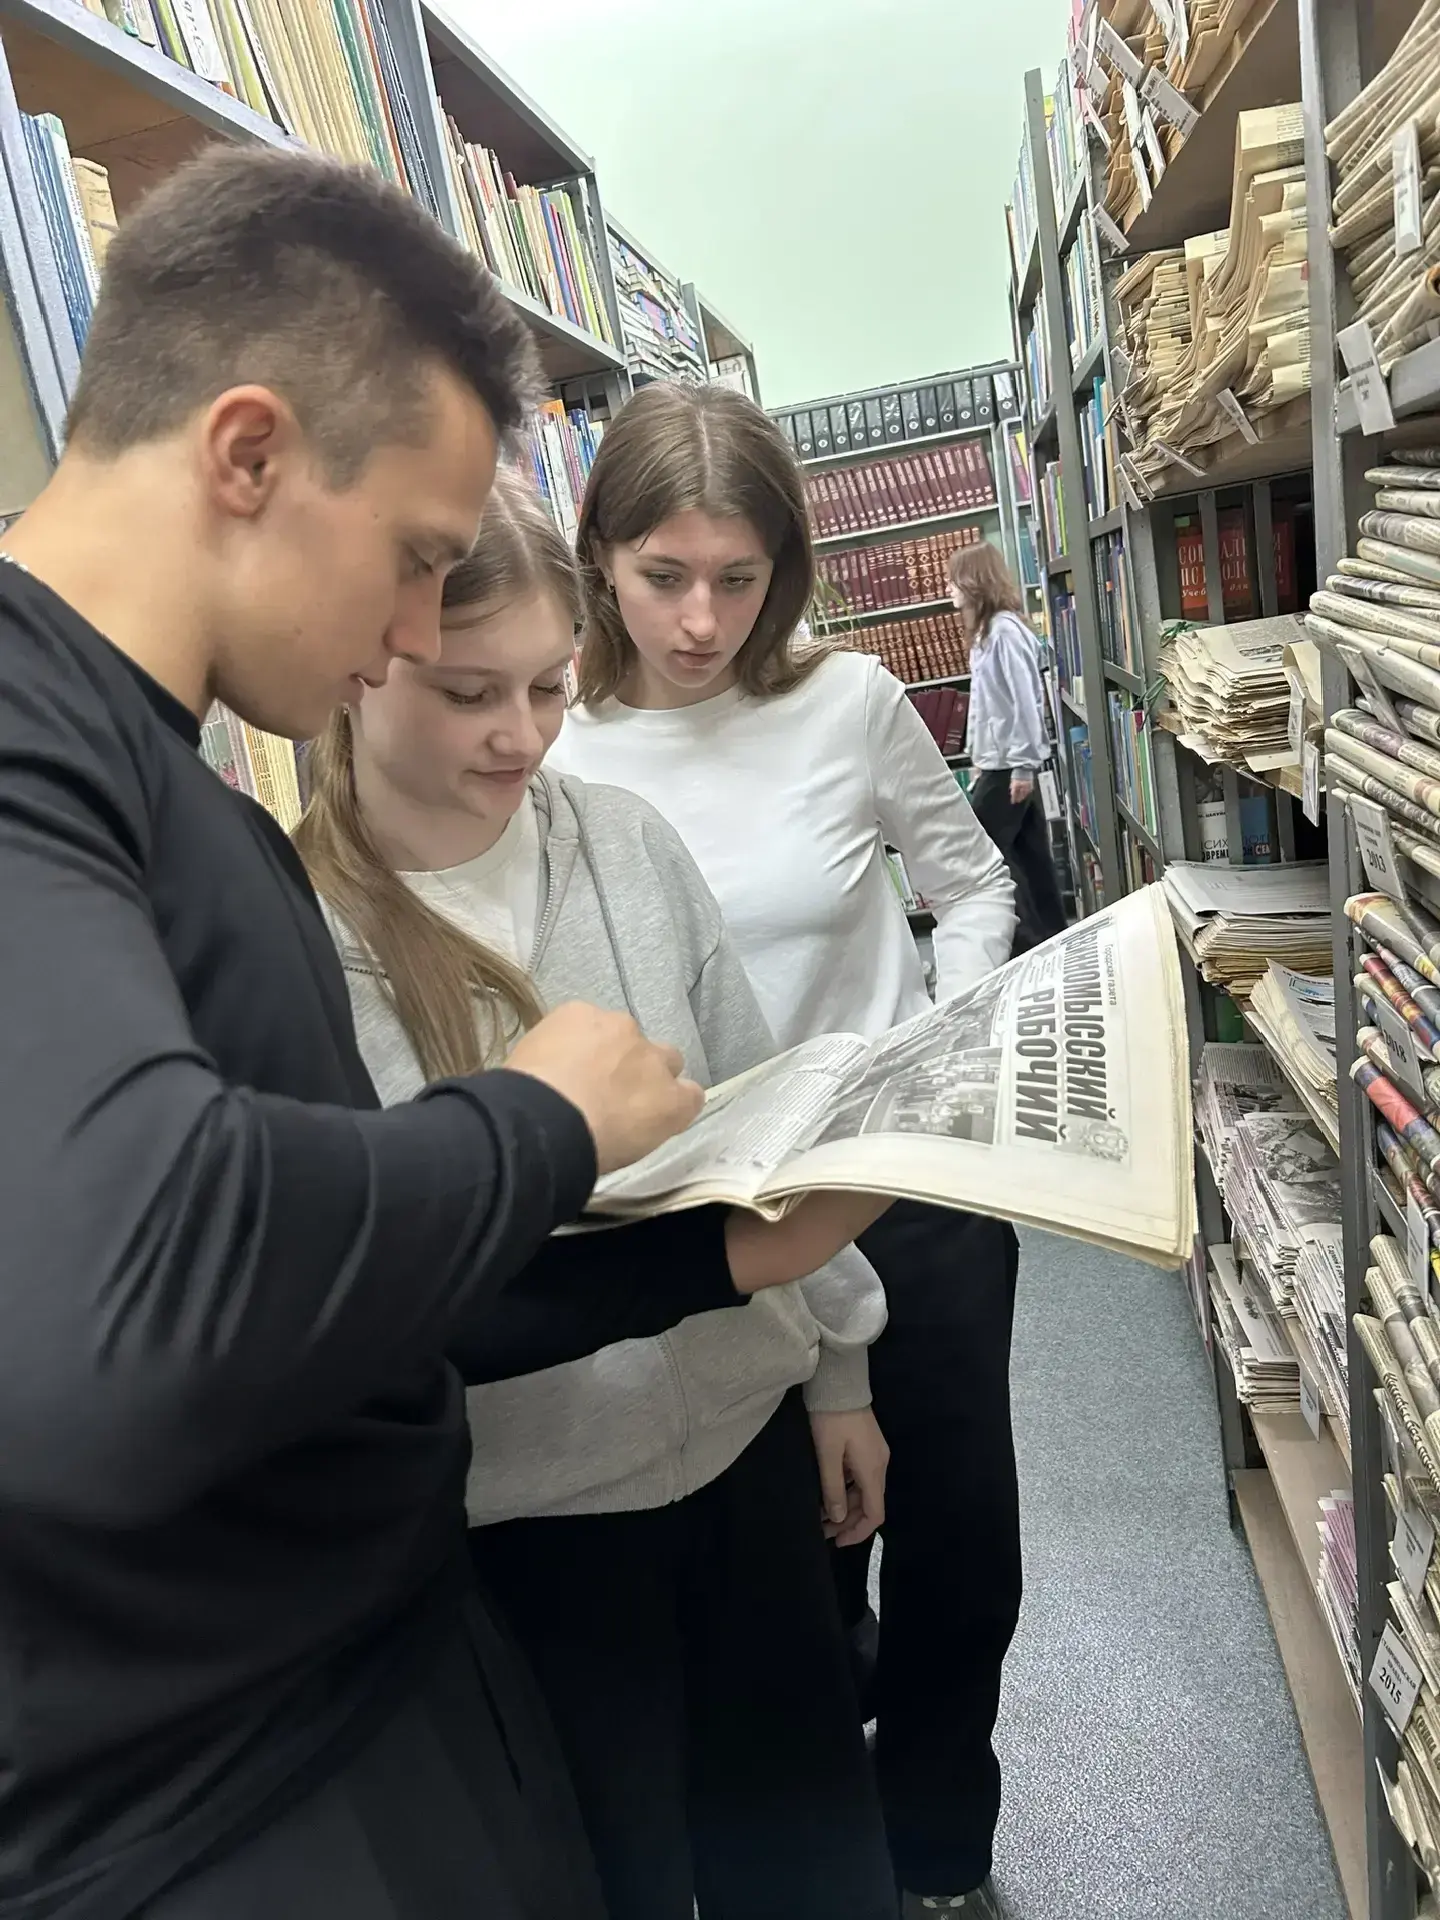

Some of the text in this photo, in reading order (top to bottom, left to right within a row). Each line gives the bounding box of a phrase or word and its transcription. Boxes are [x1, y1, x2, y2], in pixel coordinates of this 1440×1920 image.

[1061, 915, 1116, 1121] НЕВИННОМЫССКИЙ
[1103, 943, 1118, 1006] Городская газета
[1015, 988, 1067, 1143] РАБОЧИЙ
[1379, 1667, 1402, 1706] 2015
